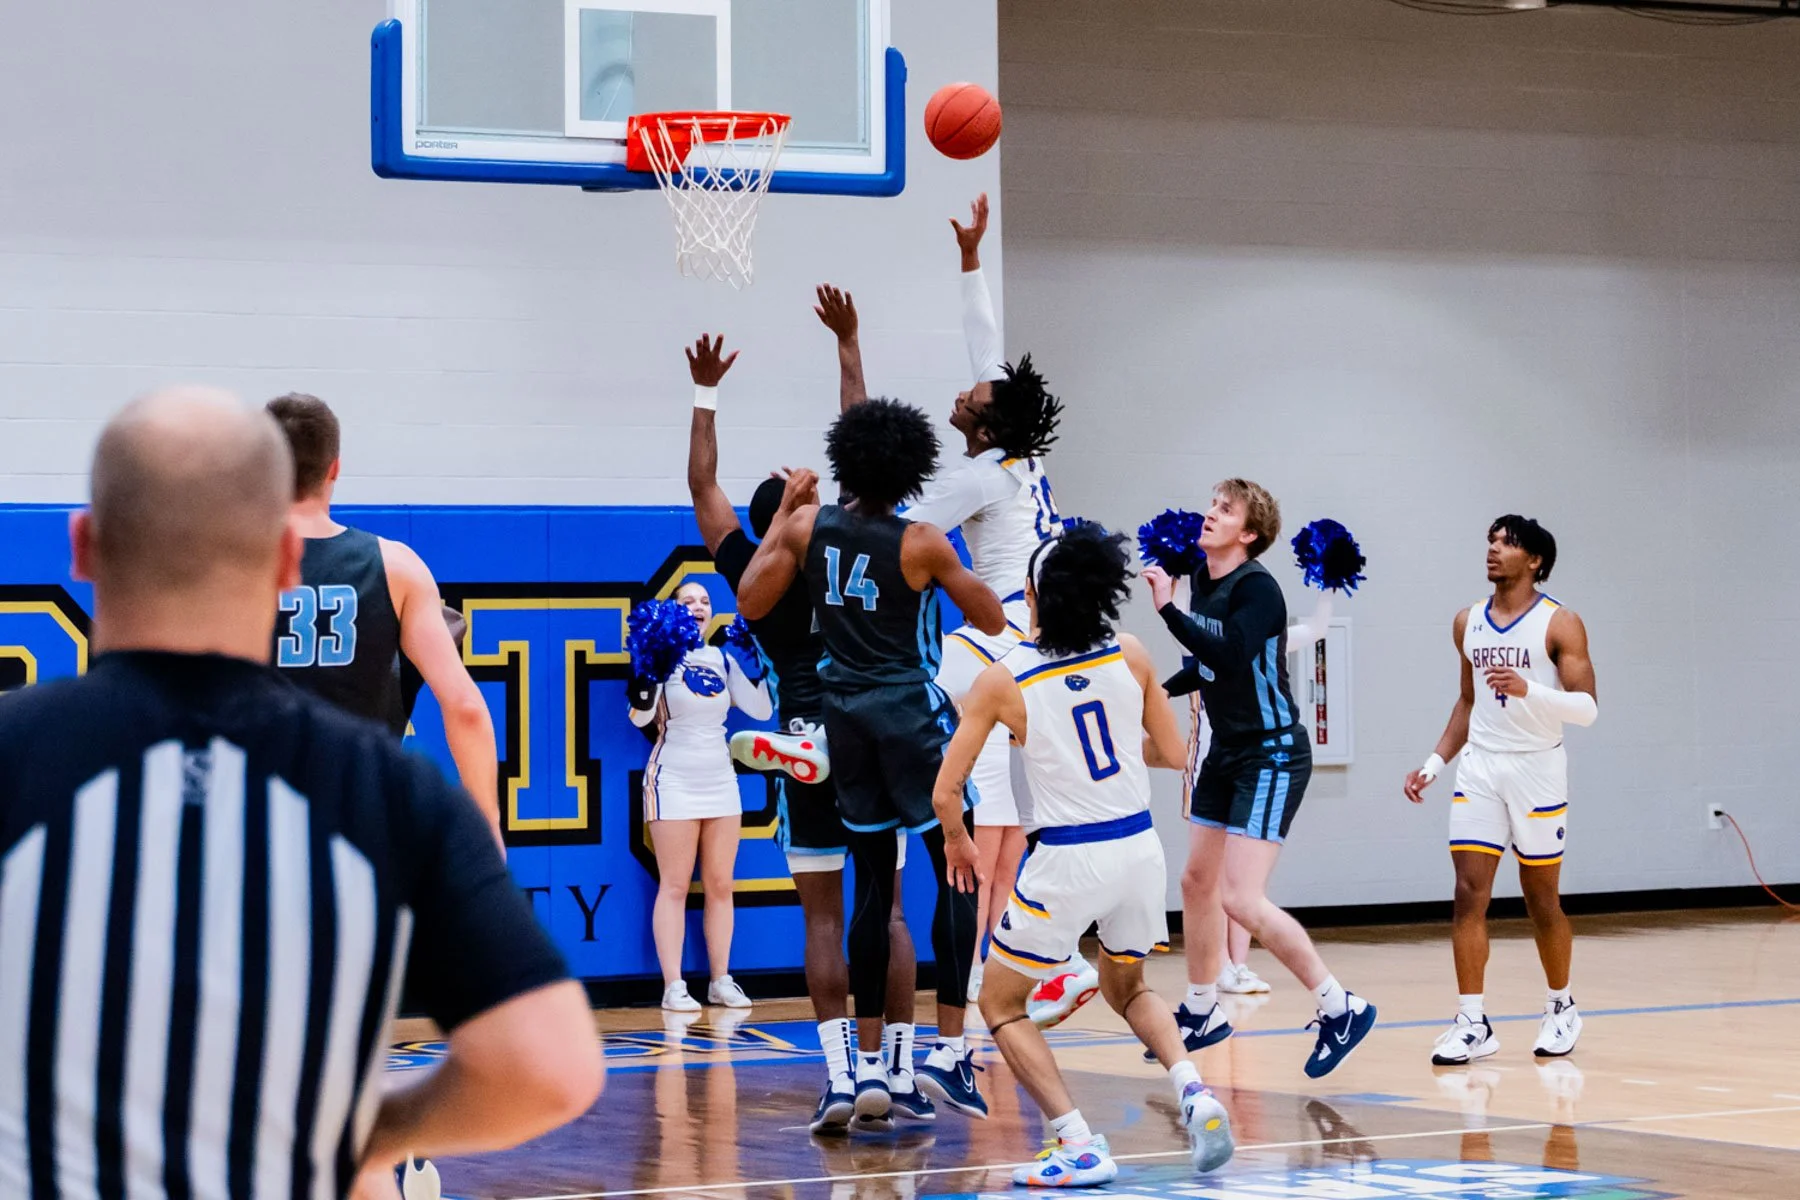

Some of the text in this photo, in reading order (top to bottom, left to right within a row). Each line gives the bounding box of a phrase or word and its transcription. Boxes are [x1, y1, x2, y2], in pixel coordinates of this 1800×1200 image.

[824, 545, 880, 612] 14
[277, 584, 359, 667] 33
[1473, 646, 1531, 669] BRESCIA
[1071, 699, 1121, 782] 0
